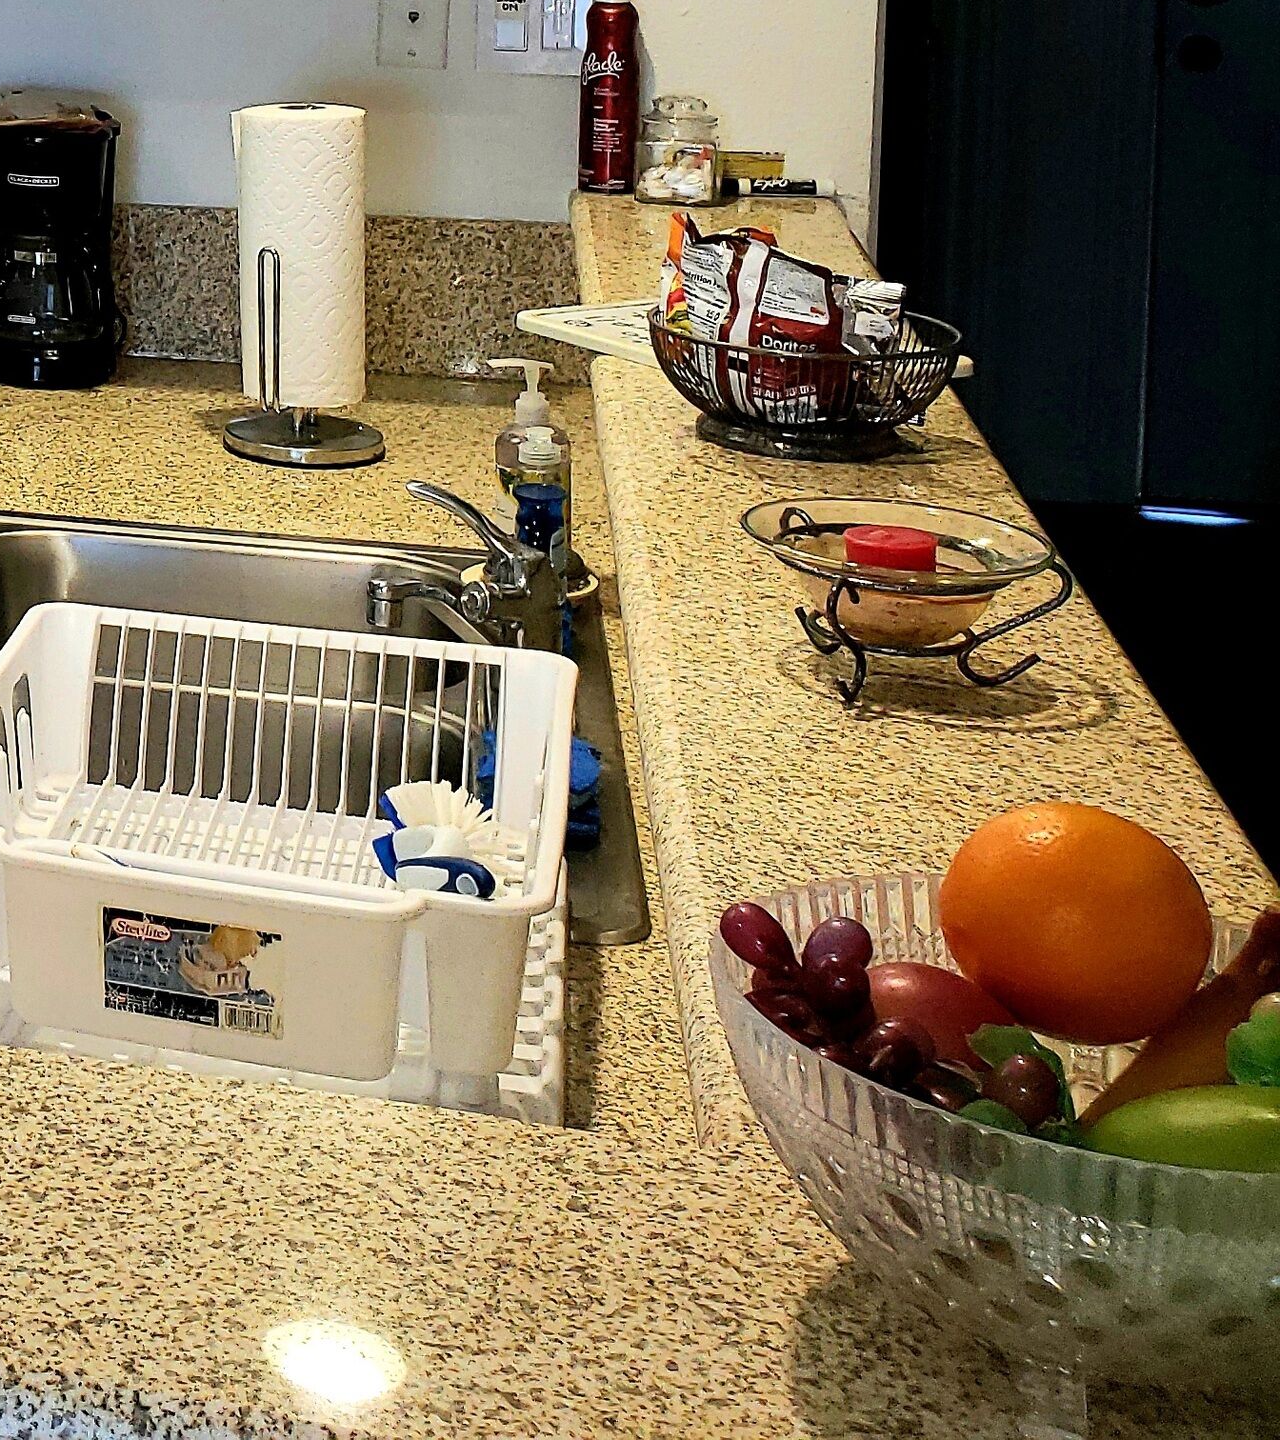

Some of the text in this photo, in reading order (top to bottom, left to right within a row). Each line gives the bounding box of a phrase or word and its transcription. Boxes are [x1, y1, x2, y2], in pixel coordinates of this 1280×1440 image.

[501, 3, 519, 12] ON
[753, 177, 788, 191] EXPO
[762, 334, 817, 353] Doritos
